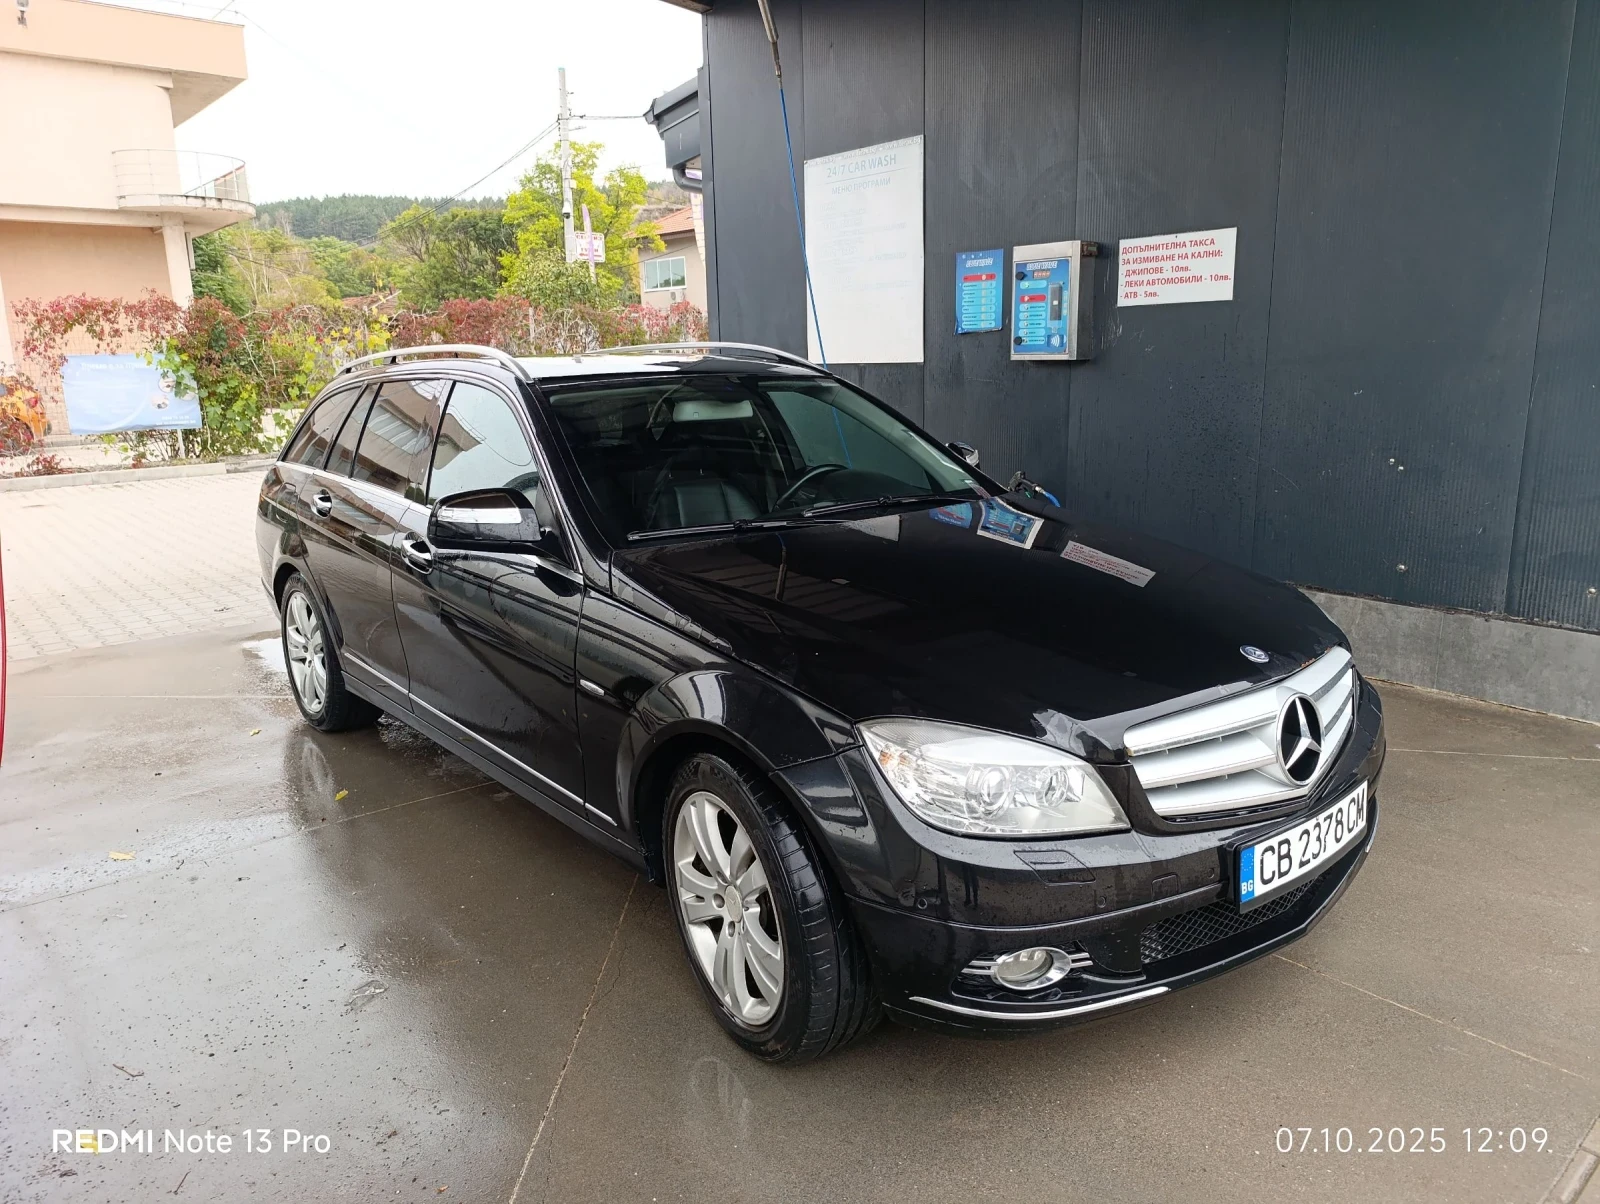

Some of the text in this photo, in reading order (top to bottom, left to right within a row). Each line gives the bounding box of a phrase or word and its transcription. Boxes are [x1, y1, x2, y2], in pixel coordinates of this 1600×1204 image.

[827, 165, 846, 178] 24/7
[848, 160, 866, 174] CAR
[868, 153, 897, 169] WASH
[832, 177, 891, 195] МЕНЮ ПРОГРАМИ
[1122, 238, 1216, 255] ДОПЪЛНИТЕЛНА ТАКСА
[1121, 249, 1223, 266] ЗА ИЗМИВАНЕ НА КАЛНИ:
[1124, 266, 1164, 278] ДЖИПОВЕ
[1170, 265, 1191, 273] 10лв.
[1124, 280, 1144, 288] ЛЕКИ
[1145, 275, 1203, 286] АВТОМОБИЛИ
[1209, 273, 1232, 282] 10лв.
[1124, 291, 1138, 299] АТВ
[1143, 290, 1160, 298] 5лв.
[1260, 788, 1365, 885] CB 2378 CM
[1241, 880, 1254, 895] BG
